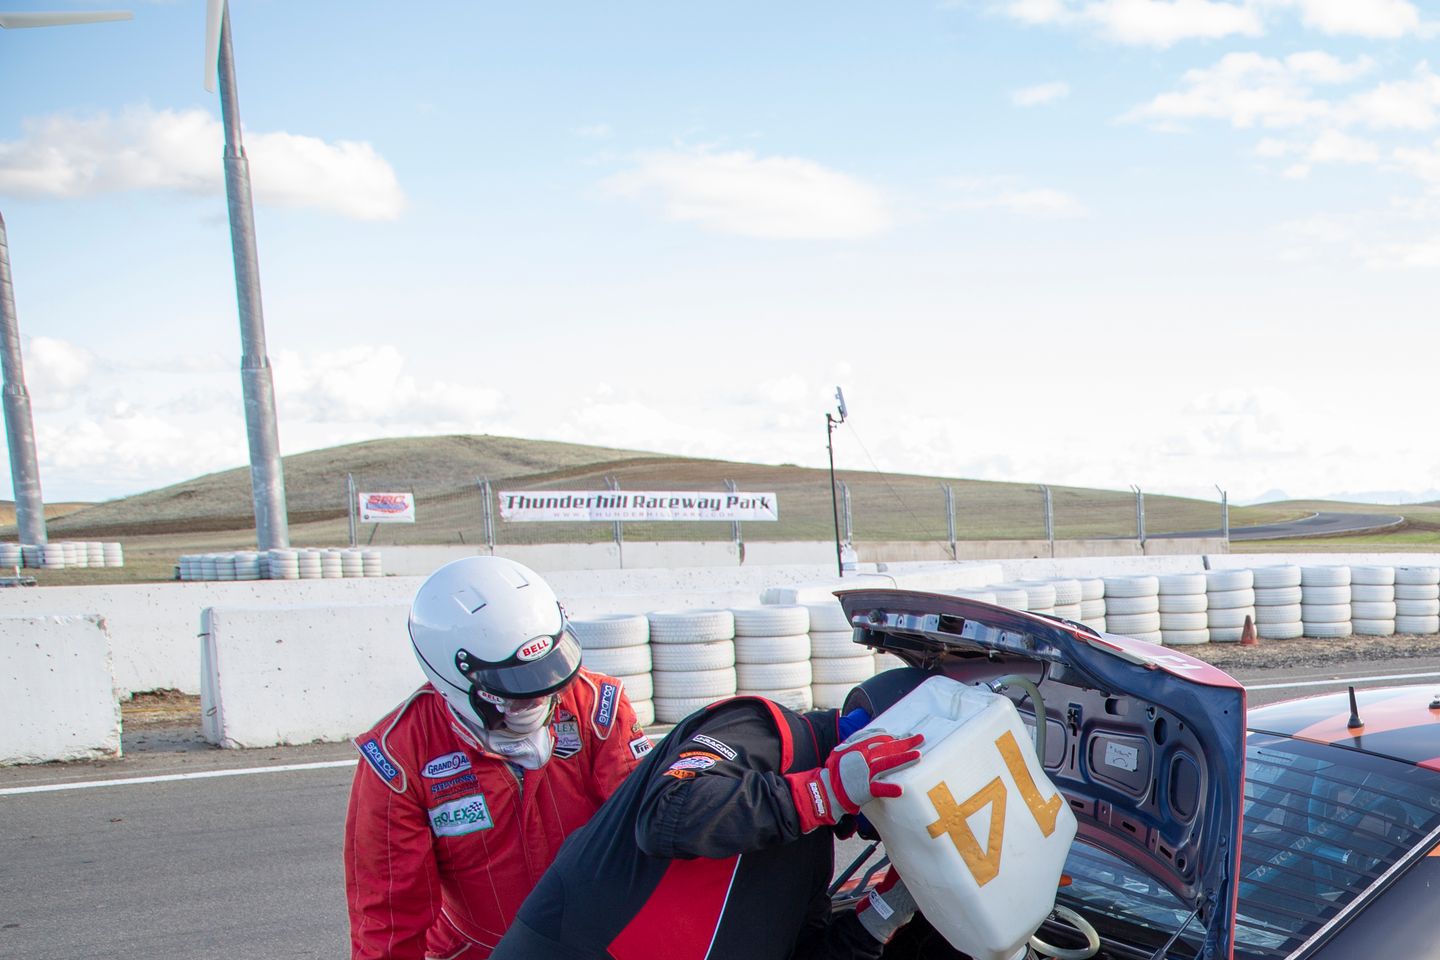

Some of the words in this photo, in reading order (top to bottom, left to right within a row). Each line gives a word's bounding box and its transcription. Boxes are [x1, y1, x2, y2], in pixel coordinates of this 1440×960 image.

[507, 495, 628, 509] Thunderhill
[632, 495, 721, 511] Raceway
[726, 495, 770, 509] Park
[522, 639, 549, 657] BELL
[598, 684, 614, 724] sparco
[366, 741, 397, 777] sparco
[468, 811, 486, 824] 24
[925, 730, 1063, 888] 14
